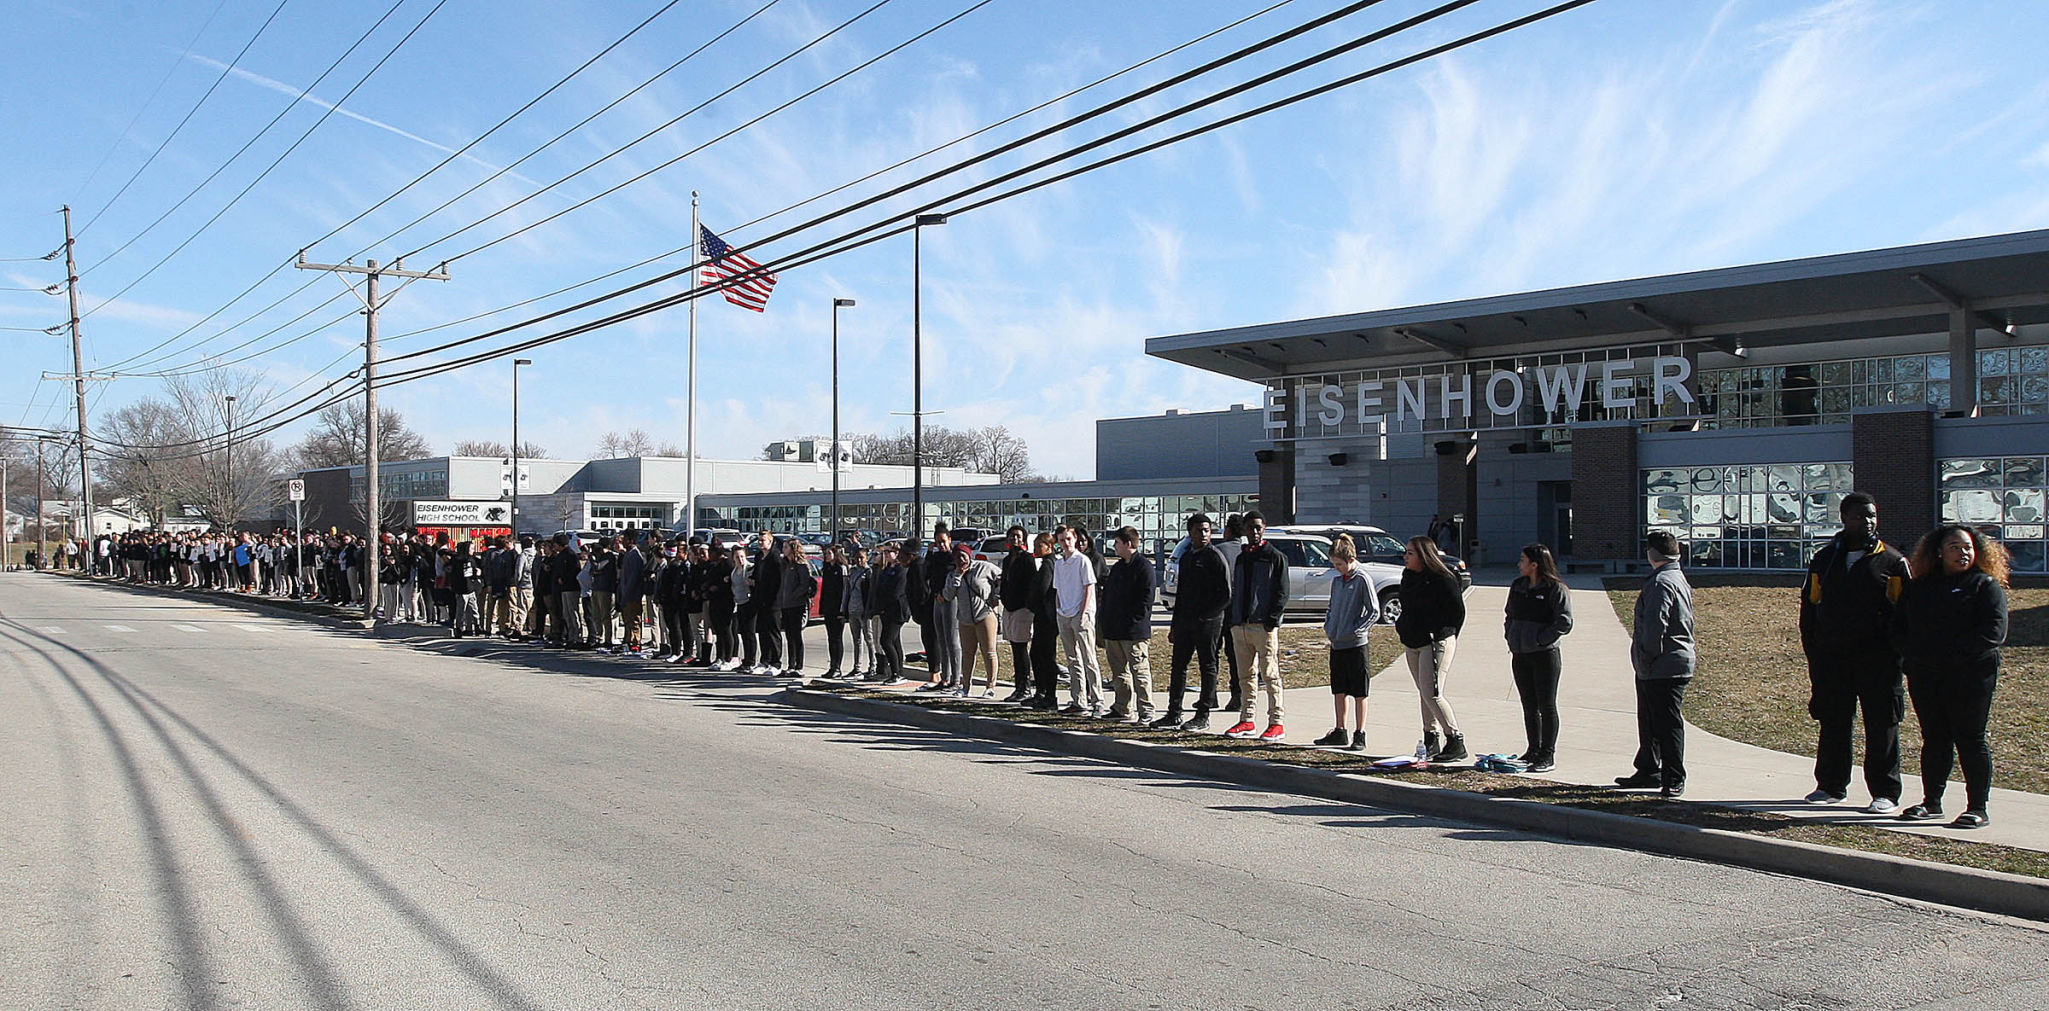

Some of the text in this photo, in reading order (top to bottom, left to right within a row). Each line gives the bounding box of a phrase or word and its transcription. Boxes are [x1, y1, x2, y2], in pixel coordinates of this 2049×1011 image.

[1263, 357, 1694, 429] EISENHOWER
[417, 504, 479, 512] EISENHOWER
[416, 514, 480, 522] HIGH SCHOOL
